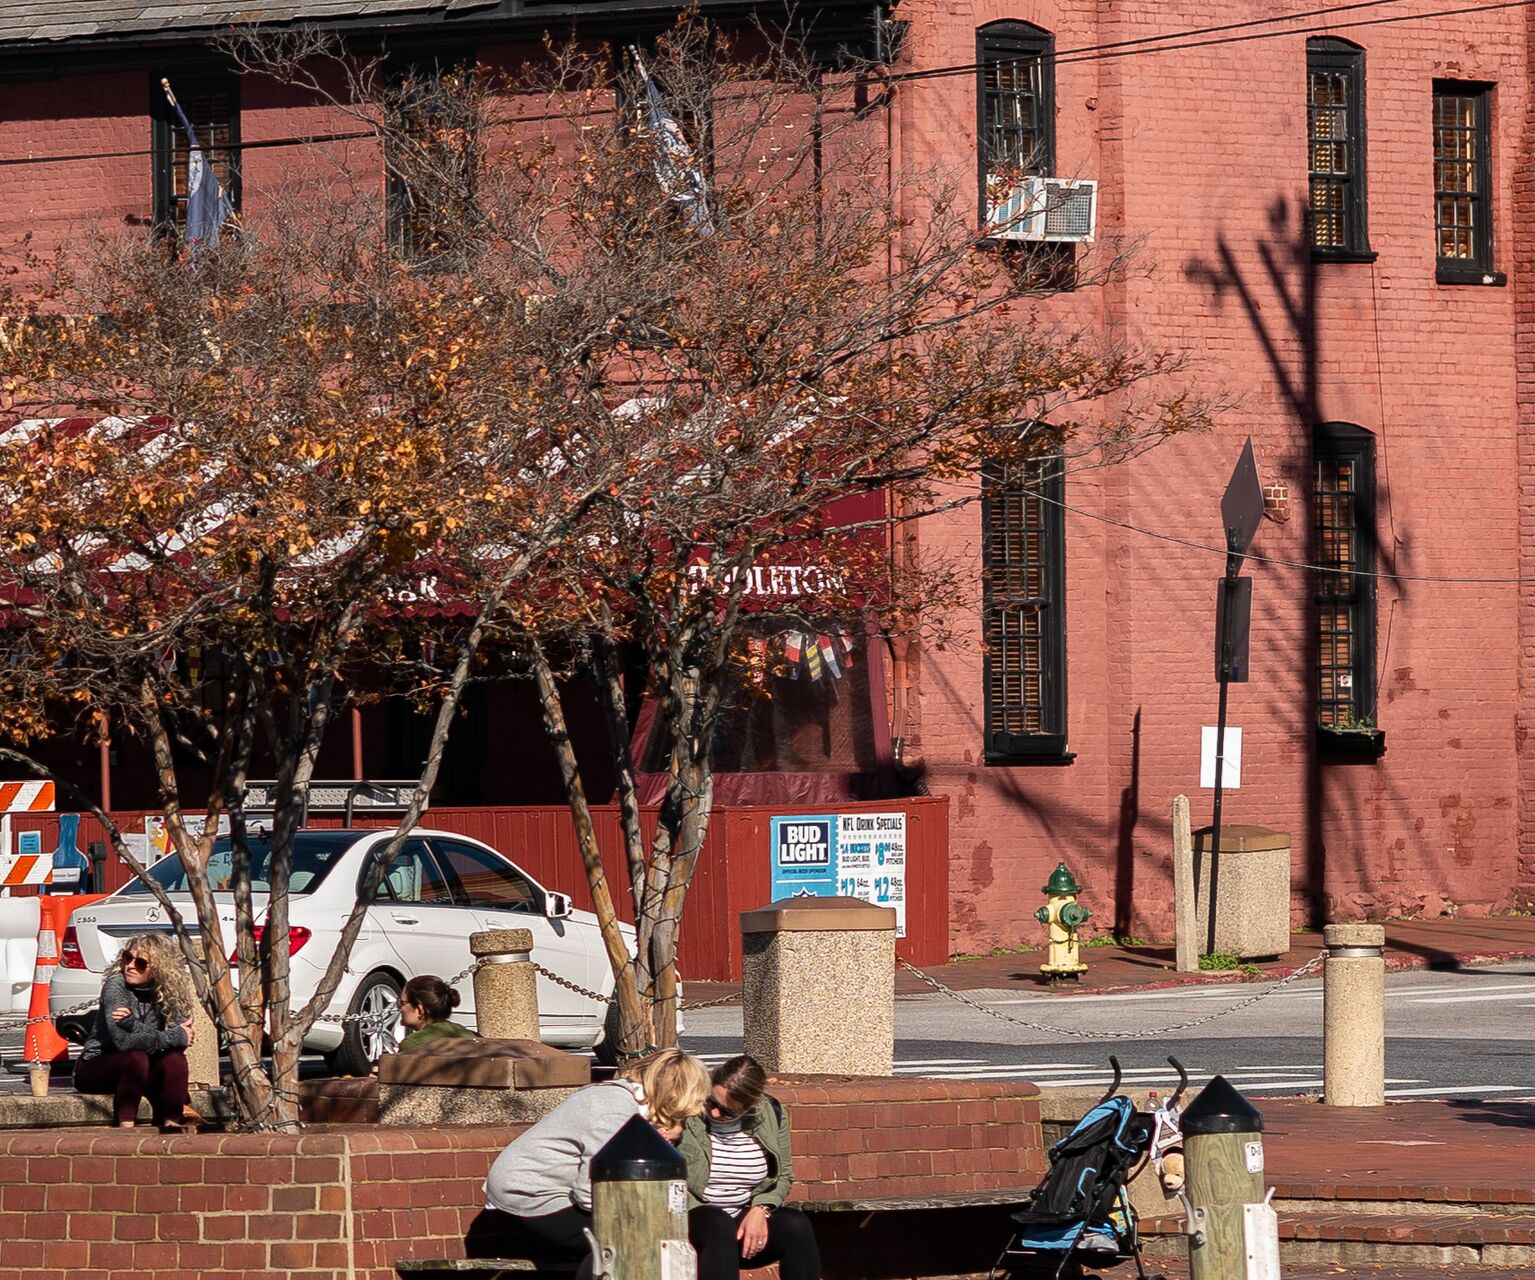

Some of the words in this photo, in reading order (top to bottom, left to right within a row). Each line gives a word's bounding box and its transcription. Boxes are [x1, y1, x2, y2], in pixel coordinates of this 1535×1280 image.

[843, 817, 854, 831] NFL
[787, 825, 821, 844] BUD
[781, 842, 827, 862] LIGHT
